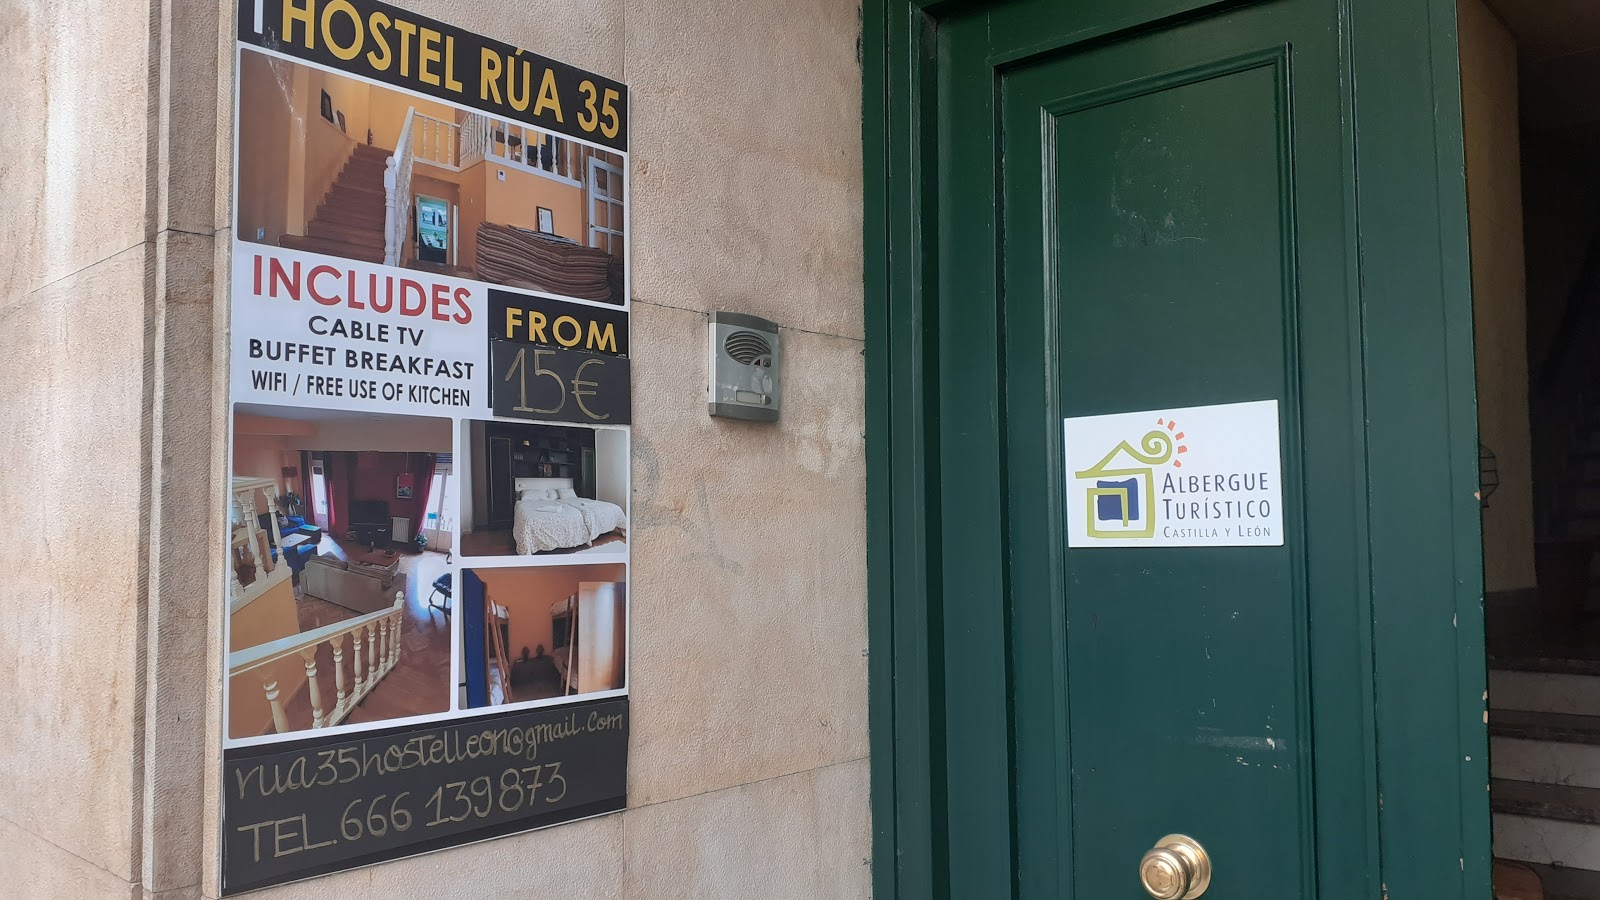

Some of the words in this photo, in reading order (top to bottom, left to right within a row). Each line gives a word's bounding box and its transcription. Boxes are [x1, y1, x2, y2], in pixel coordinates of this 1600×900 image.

[281, 0, 463, 94] HOSTEL
[480, 48, 564, 124] RÚA
[576, 80, 620, 139] 35
[253, 254, 473, 325] INCLUDES
[308, 315, 390, 343] CABLE
[397, 326, 425, 347] TV
[506, 306, 618, 353] FROM
[248, 339, 342, 366] BUFFET
[345, 350, 475, 380] BREAKFAST
[251, 369, 288, 393] WIFI
[306, 375, 344, 397] FREE
[348, 378, 377, 401] USE
[381, 381, 404, 402] OF
[408, 383, 471, 407] KITCHEN
[504, 348, 610, 420] 15€
[1162, 472, 1269, 494] ALBERGUE
[1162, 497, 1271, 520] TURÍSTICO
[1163, 526, 1218, 538] CASTILLA
[1238, 525, 1271, 537] LEÓN
